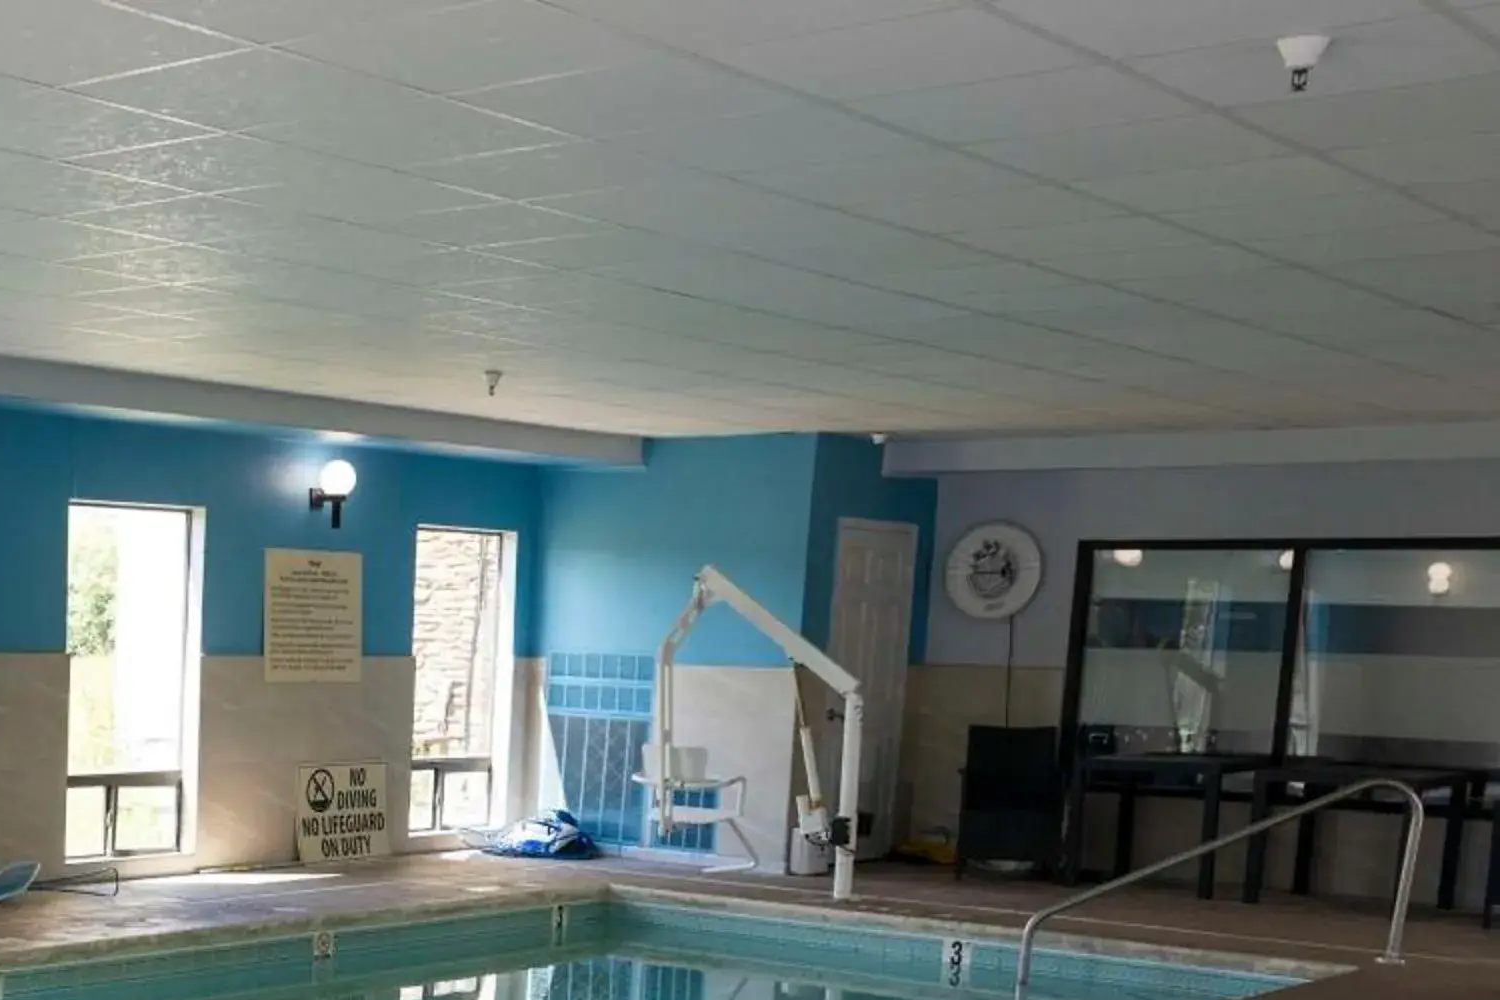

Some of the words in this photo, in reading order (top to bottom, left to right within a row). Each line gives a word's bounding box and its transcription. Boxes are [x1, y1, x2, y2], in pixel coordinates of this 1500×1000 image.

[349, 767, 367, 786] NO
[337, 788, 377, 810] DIVING
[301, 817, 319, 837] NO
[321, 811, 385, 835] LIFEGUARD
[321, 838, 339, 857] ON
[341, 835, 371, 856] DUTY
[951, 940, 962, 965] 3
